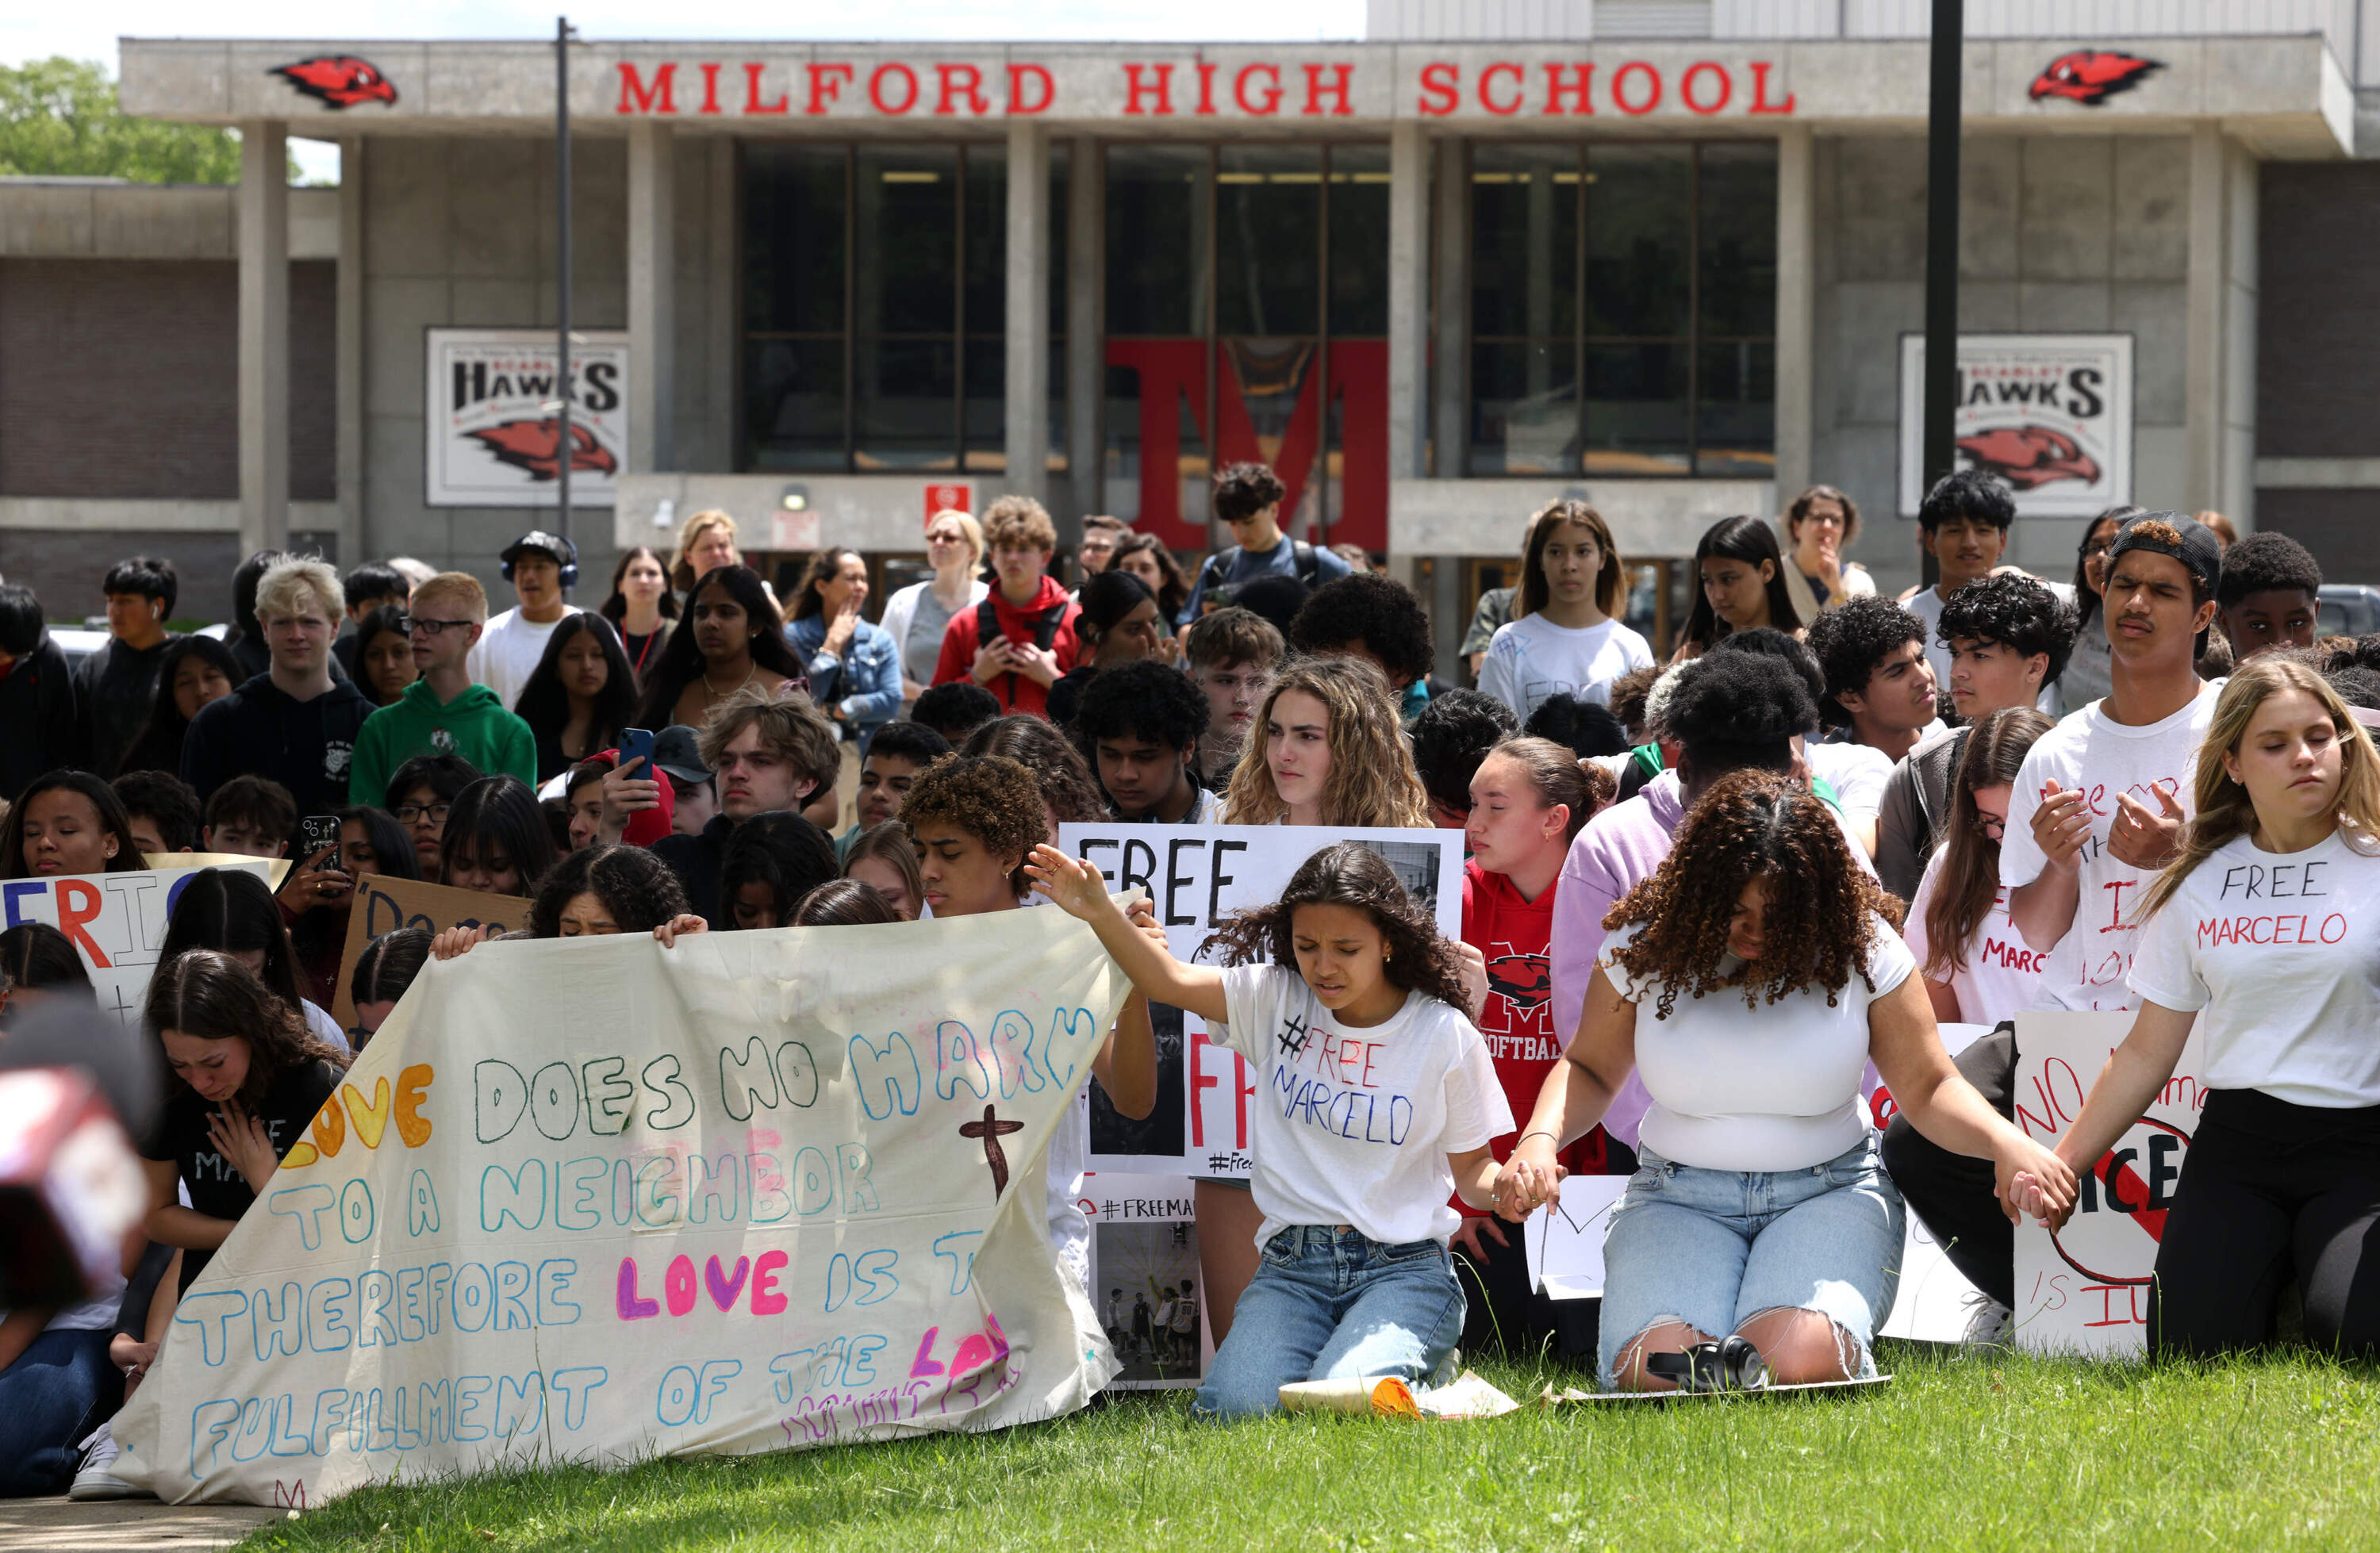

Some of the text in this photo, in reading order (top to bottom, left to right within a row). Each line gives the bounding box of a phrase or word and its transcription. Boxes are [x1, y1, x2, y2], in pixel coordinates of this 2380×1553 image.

[616, 61, 1796, 116] MILFORD HIGH SCHOOL
[1080, 838, 1248, 928] FREE
[2221, 861, 2328, 901] FREE
[1983, 938, 2049, 973] MARC
[2198, 912, 2347, 950] MARCELO
[1277, 1013, 1387, 1088] #FREE
[1484, 1033, 1562, 1060] OFTBAL
[475, 1054, 695, 1144] DOES
[720, 1036, 819, 1122] NO
[1273, 1064, 1413, 1146] MARCELO
[2016, 1056, 2085, 1138] NO
[271, 1142, 881, 1251] TO A NEIGHBOR
[1209, 1151, 1253, 1174] #Free
[2079, 1133, 2179, 1214] ICE
[1101, 1198, 1196, 1221] #FREEMA
[175, 1259, 581, 1366] THEREFORE
[616, 1249, 789, 1321] LOVE
[824, 1248, 899, 1312] IS
[2030, 1271, 2069, 1310] IS
[191, 1367, 608, 1480] FULFILLMENT
[657, 1359, 742, 1426] OF
[769, 1334, 888, 1403] THE
